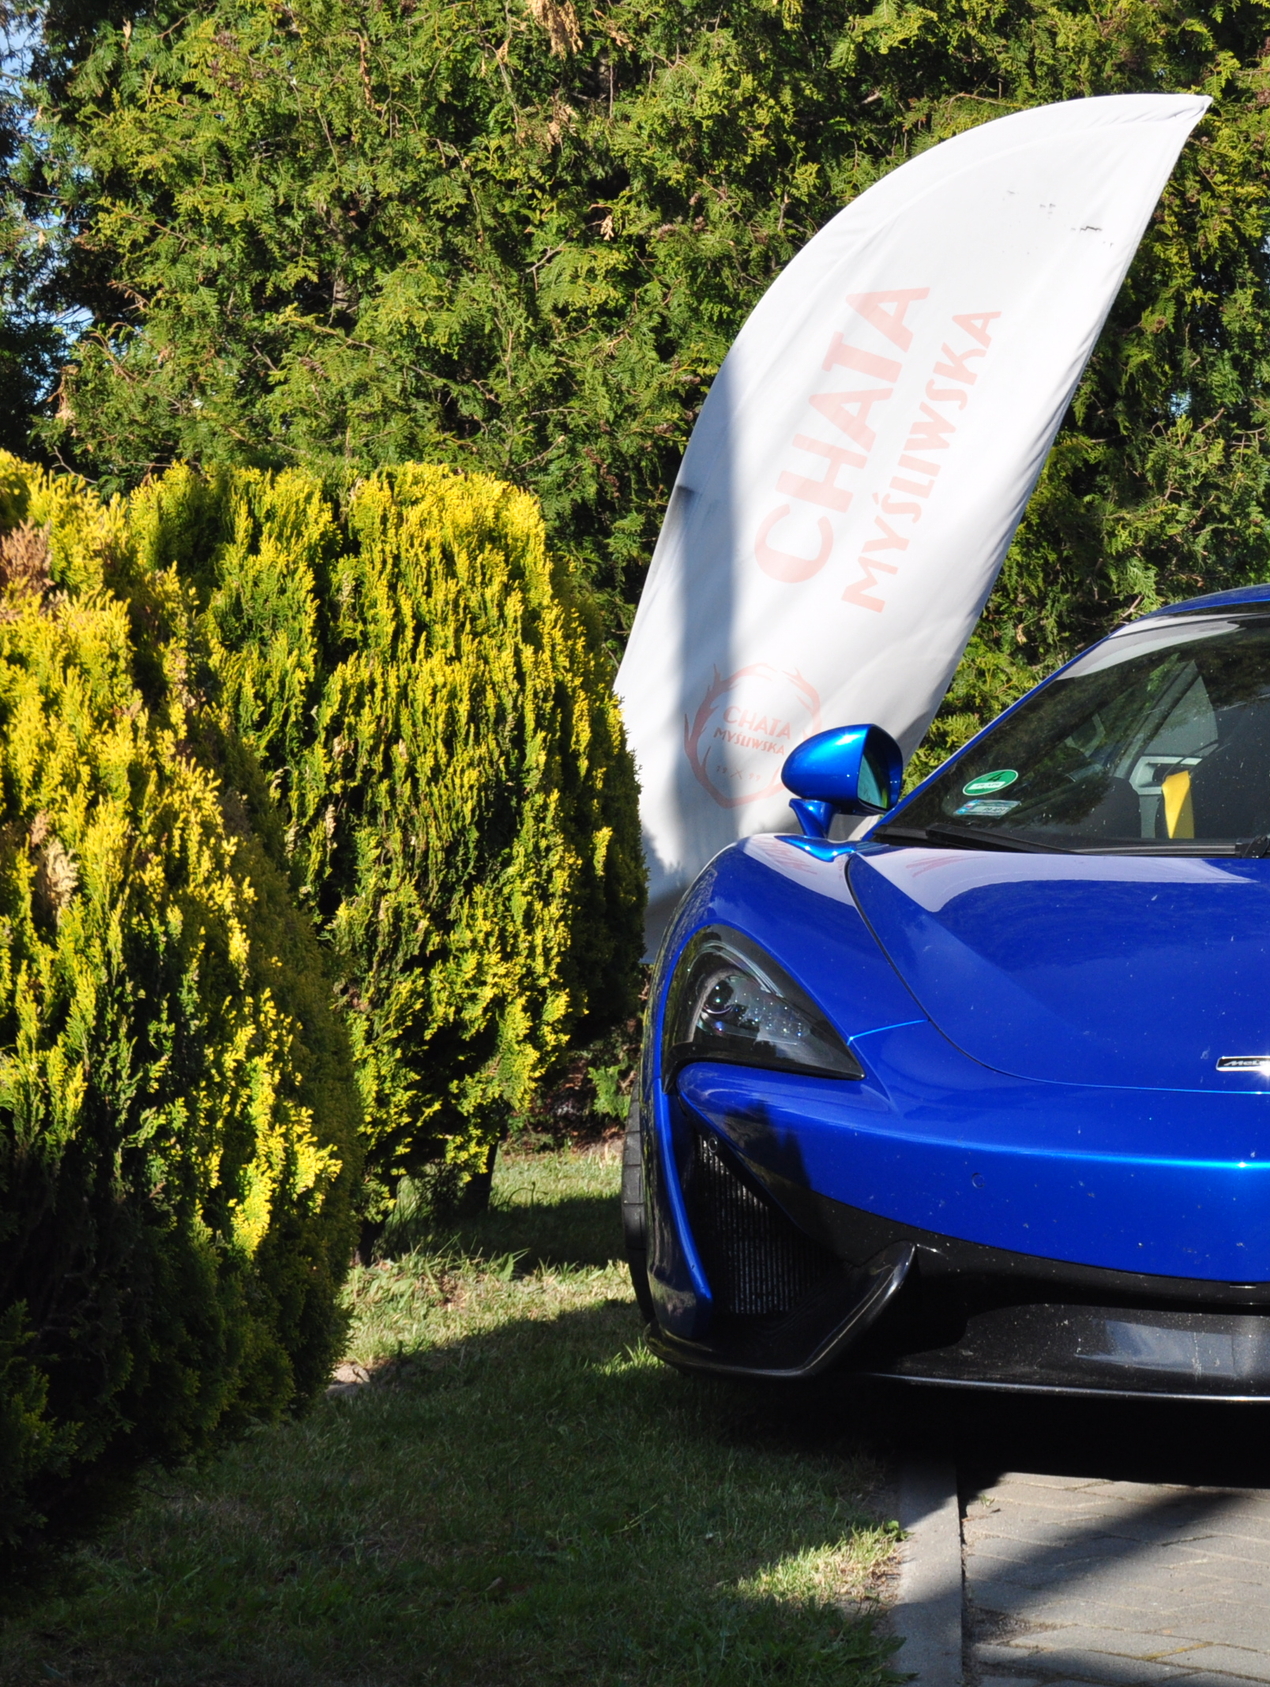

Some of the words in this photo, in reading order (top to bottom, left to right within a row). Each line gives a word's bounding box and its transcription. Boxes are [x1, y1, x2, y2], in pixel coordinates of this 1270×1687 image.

[754, 287, 930, 584] CHATA
[840, 310, 1002, 613] MYŚLIWSKA
[713, 727, 785, 755] MYŚLIWSKA
[723, 705, 791, 740] CHATA
